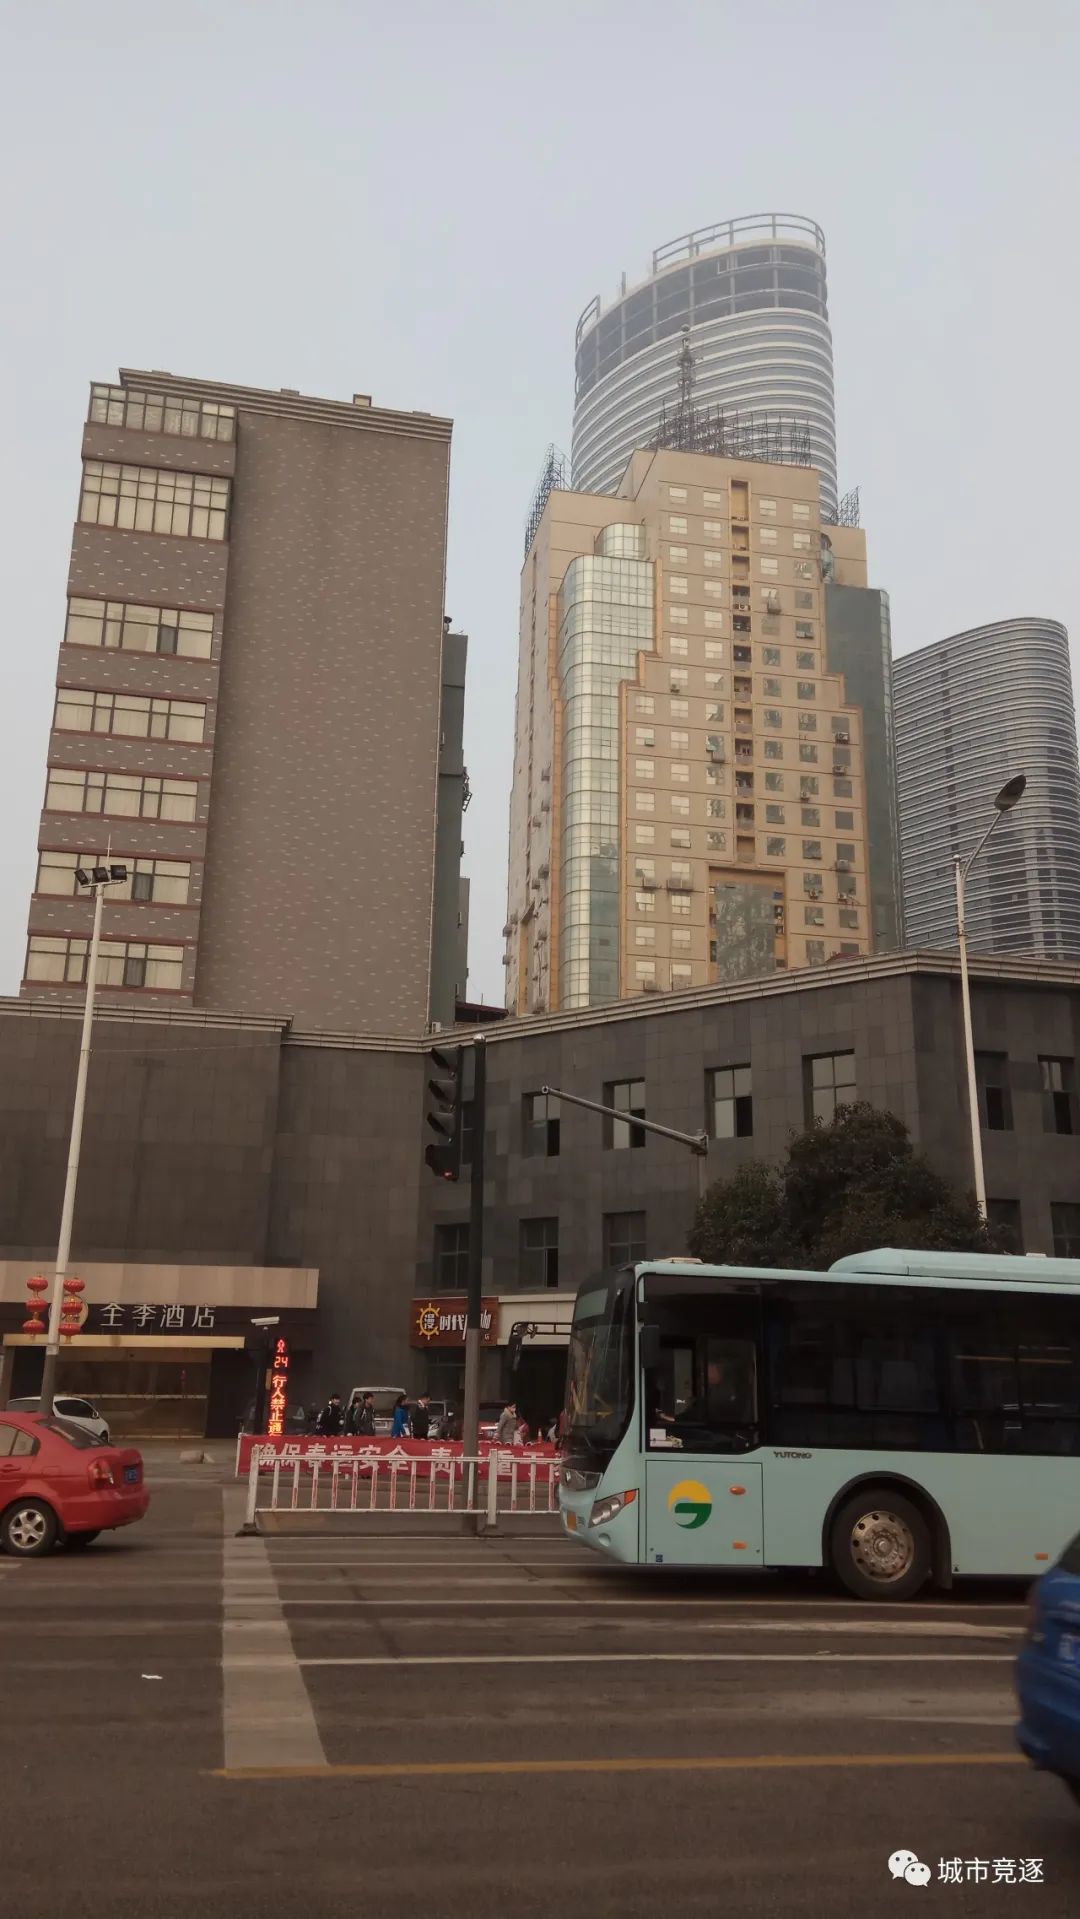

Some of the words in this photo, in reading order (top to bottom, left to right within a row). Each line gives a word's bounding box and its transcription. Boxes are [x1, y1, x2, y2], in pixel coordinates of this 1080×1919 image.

[100, 1302, 217, 1328] 全季酒店
[274, 1356, 288, 1368] 24
[268, 1375, 287, 1436] 行人禁止通
[773, 1451, 812, 1459] YUTONG
